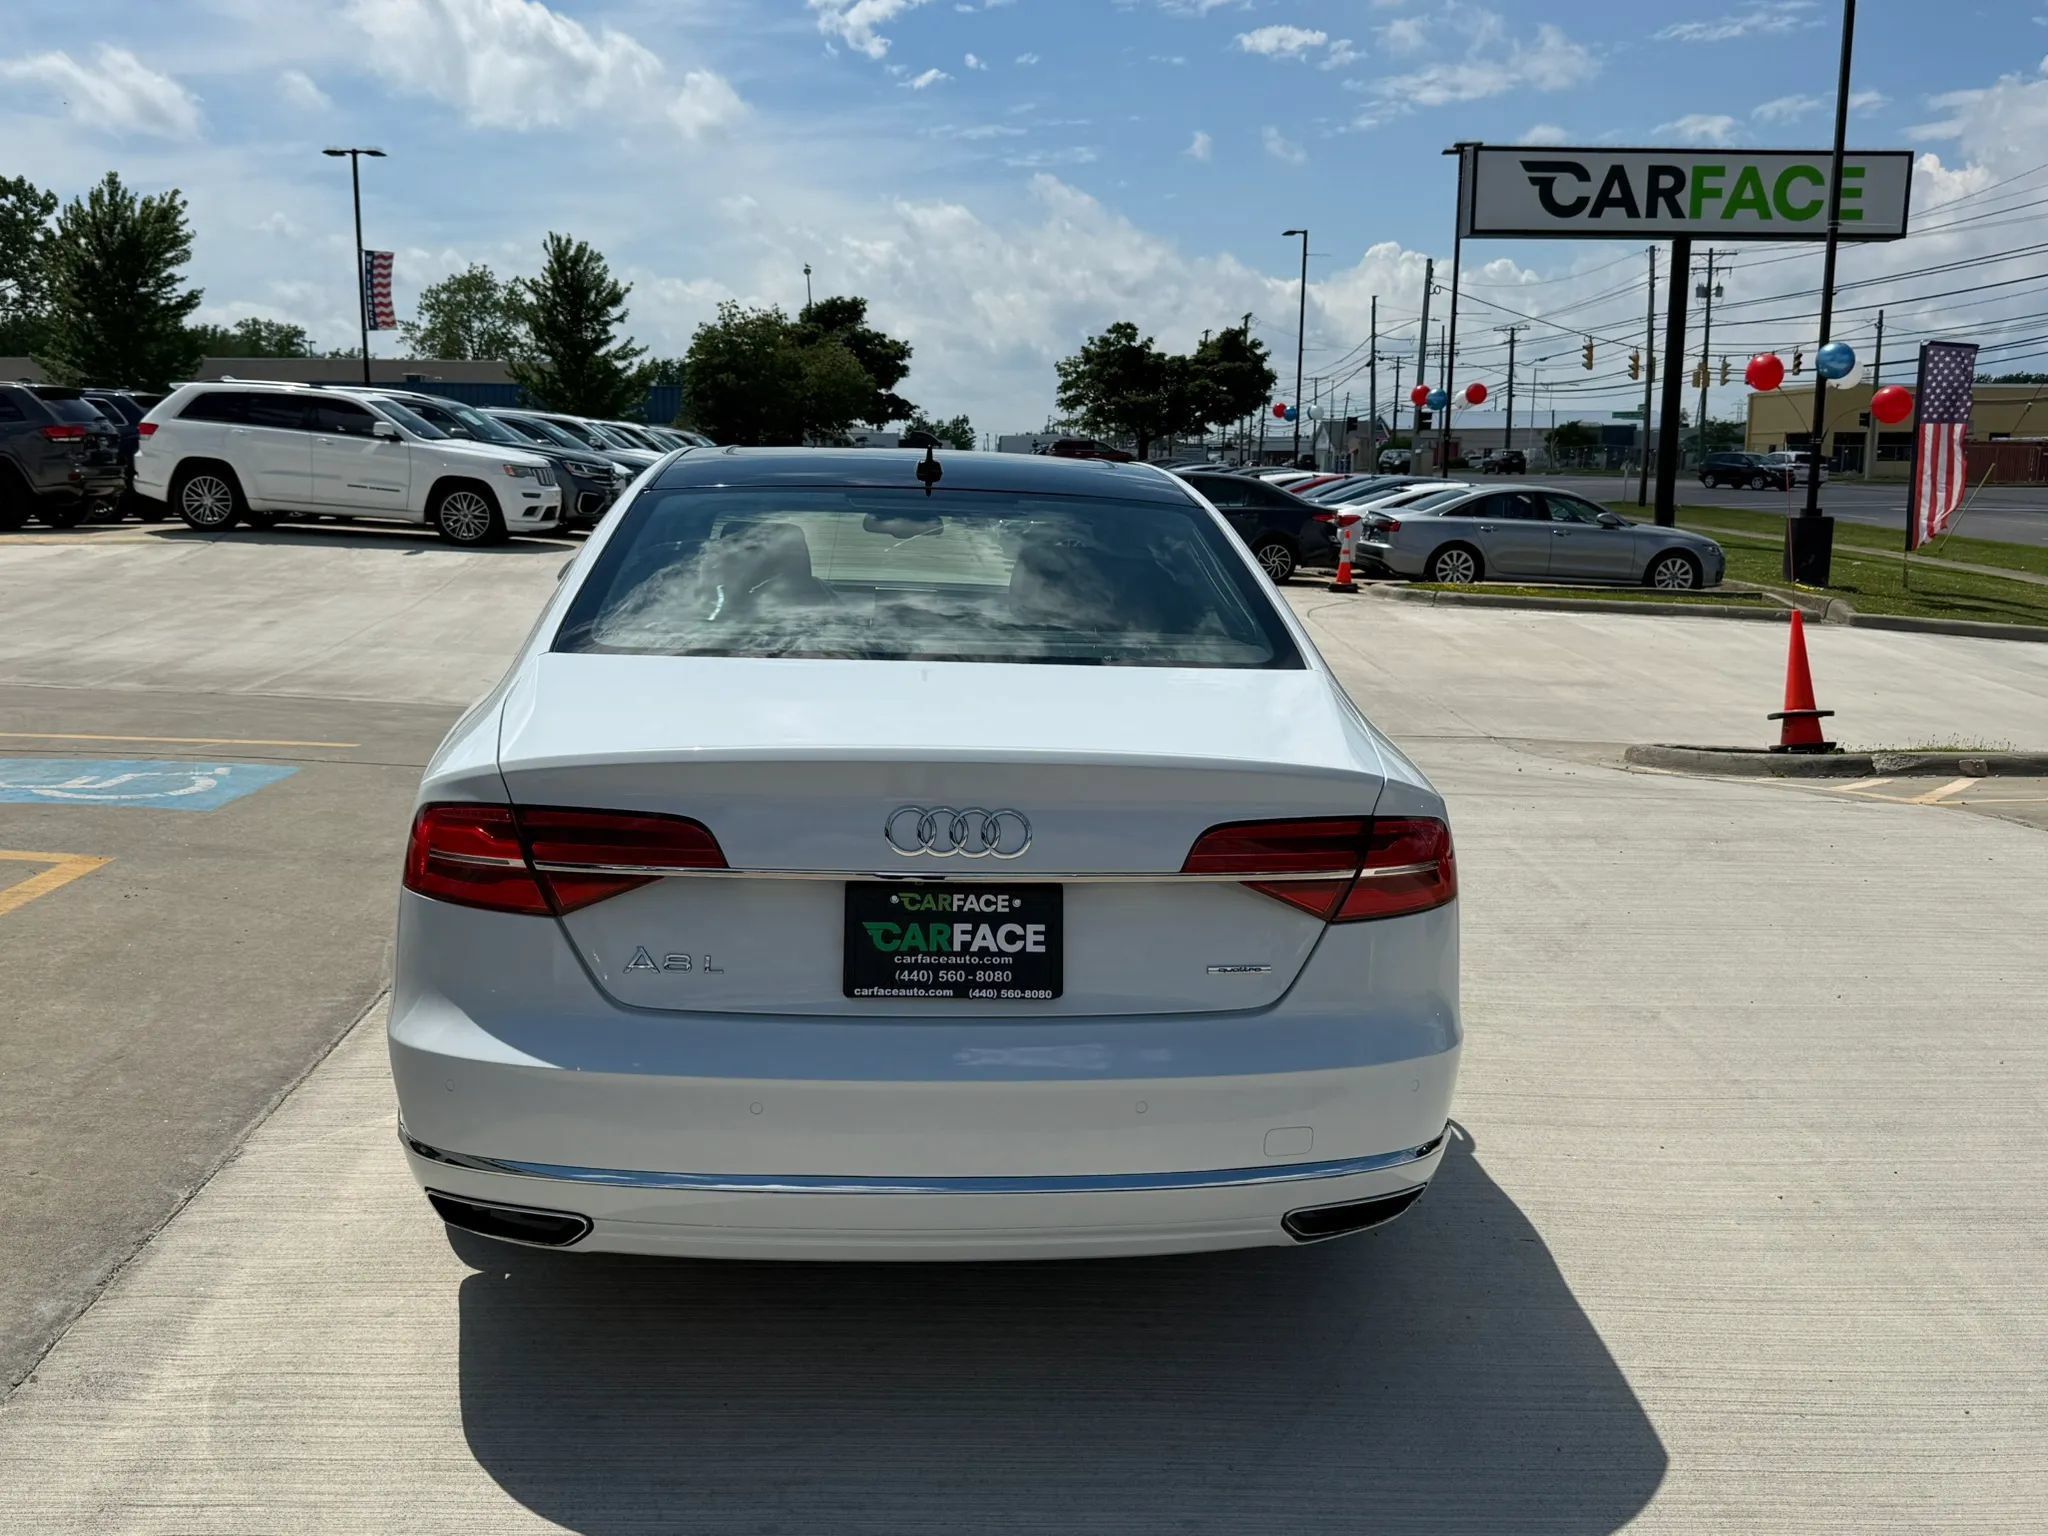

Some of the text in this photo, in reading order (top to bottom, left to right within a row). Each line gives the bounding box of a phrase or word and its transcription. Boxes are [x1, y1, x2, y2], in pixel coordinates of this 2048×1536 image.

[1519, 160, 1866, 221] CARFACE
[898, 892, 1010, 912] CARFACE
[862, 921, 1046, 953] CARFACE
[894, 953, 1013, 965] carfaceauto.com
[895, 970, 933, 984] (440)
[854, 986, 953, 997] carfaceauto.com
[968, 988, 1052, 999] (440) 560-8080
